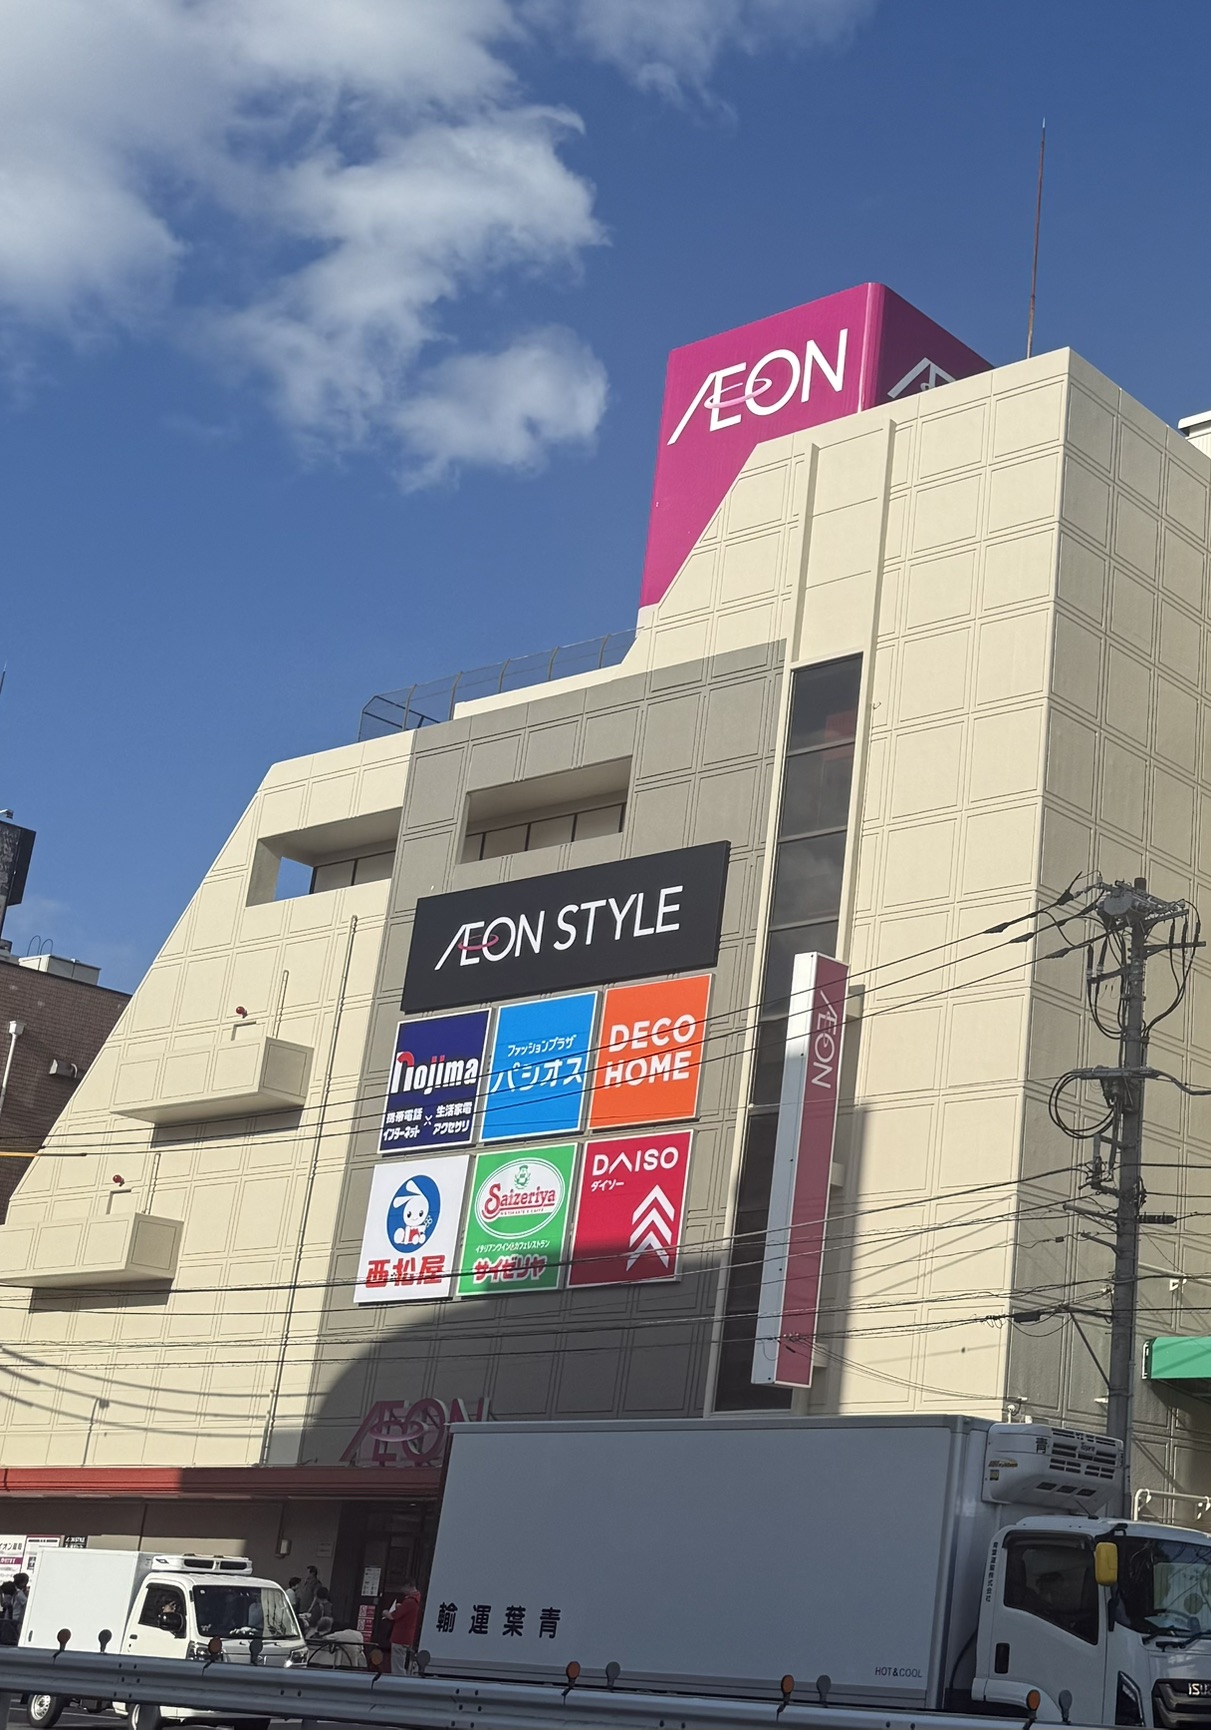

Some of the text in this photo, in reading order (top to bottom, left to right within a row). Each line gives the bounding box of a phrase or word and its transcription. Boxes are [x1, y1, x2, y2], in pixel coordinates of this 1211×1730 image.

[553, 884, 684, 951] STYLE
[608, 1013, 698, 1054] DECO
[490, 1058, 583, 1094] パシオス
[604, 1050, 691, 1090] HOME
[591, 1145, 680, 1175] DAISO
[480, 1181, 557, 1220] Saizeriya
[590, 1178, 625, 1193] ダイソー
[365, 1254, 446, 1289] 西松屋
[473, 1254, 547, 1284] サイゼリヤ
[874, 1665, 924, 1679] HOT&COOL
